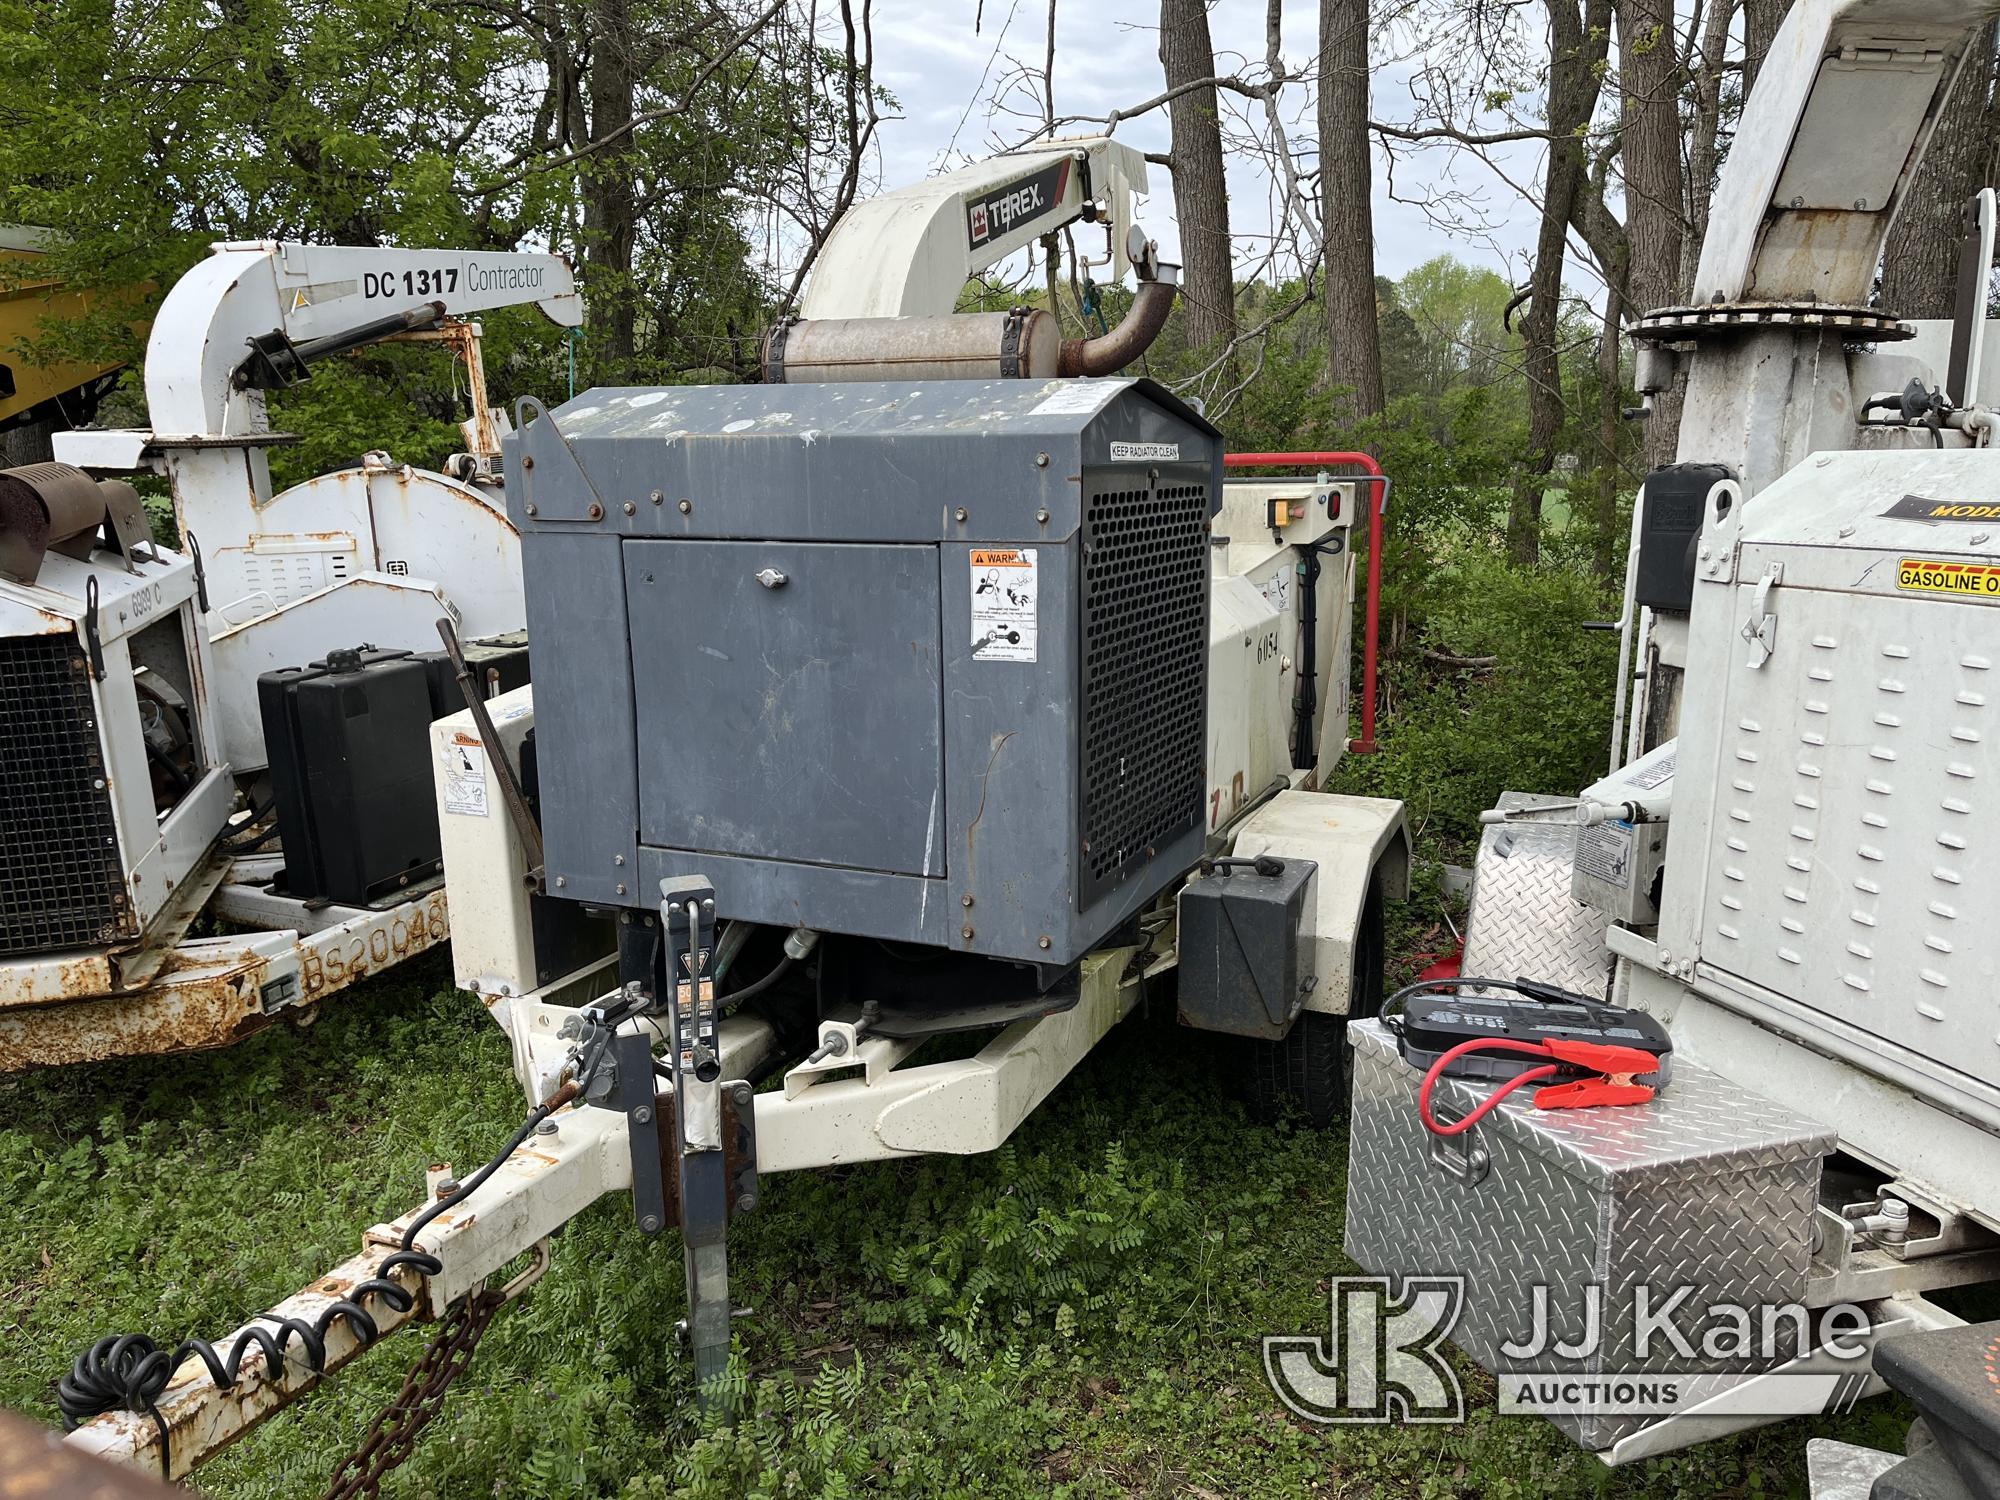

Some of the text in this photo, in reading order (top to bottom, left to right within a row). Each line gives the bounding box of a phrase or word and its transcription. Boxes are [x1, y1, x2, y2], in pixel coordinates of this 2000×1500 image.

[989, 183, 1041, 228] TEREX
[364, 263, 544, 299] DC 1317 Contractor
[1112, 446, 1177, 457] KEEP RADIATOR CLEAN
[1929, 505, 2000, 518] MODE
[988, 553, 1020, 564] WARN
[1900, 570, 2000, 592] GASOLINE O
[154, 582, 162, 605] C
[1257, 632, 1278, 665] 6054
